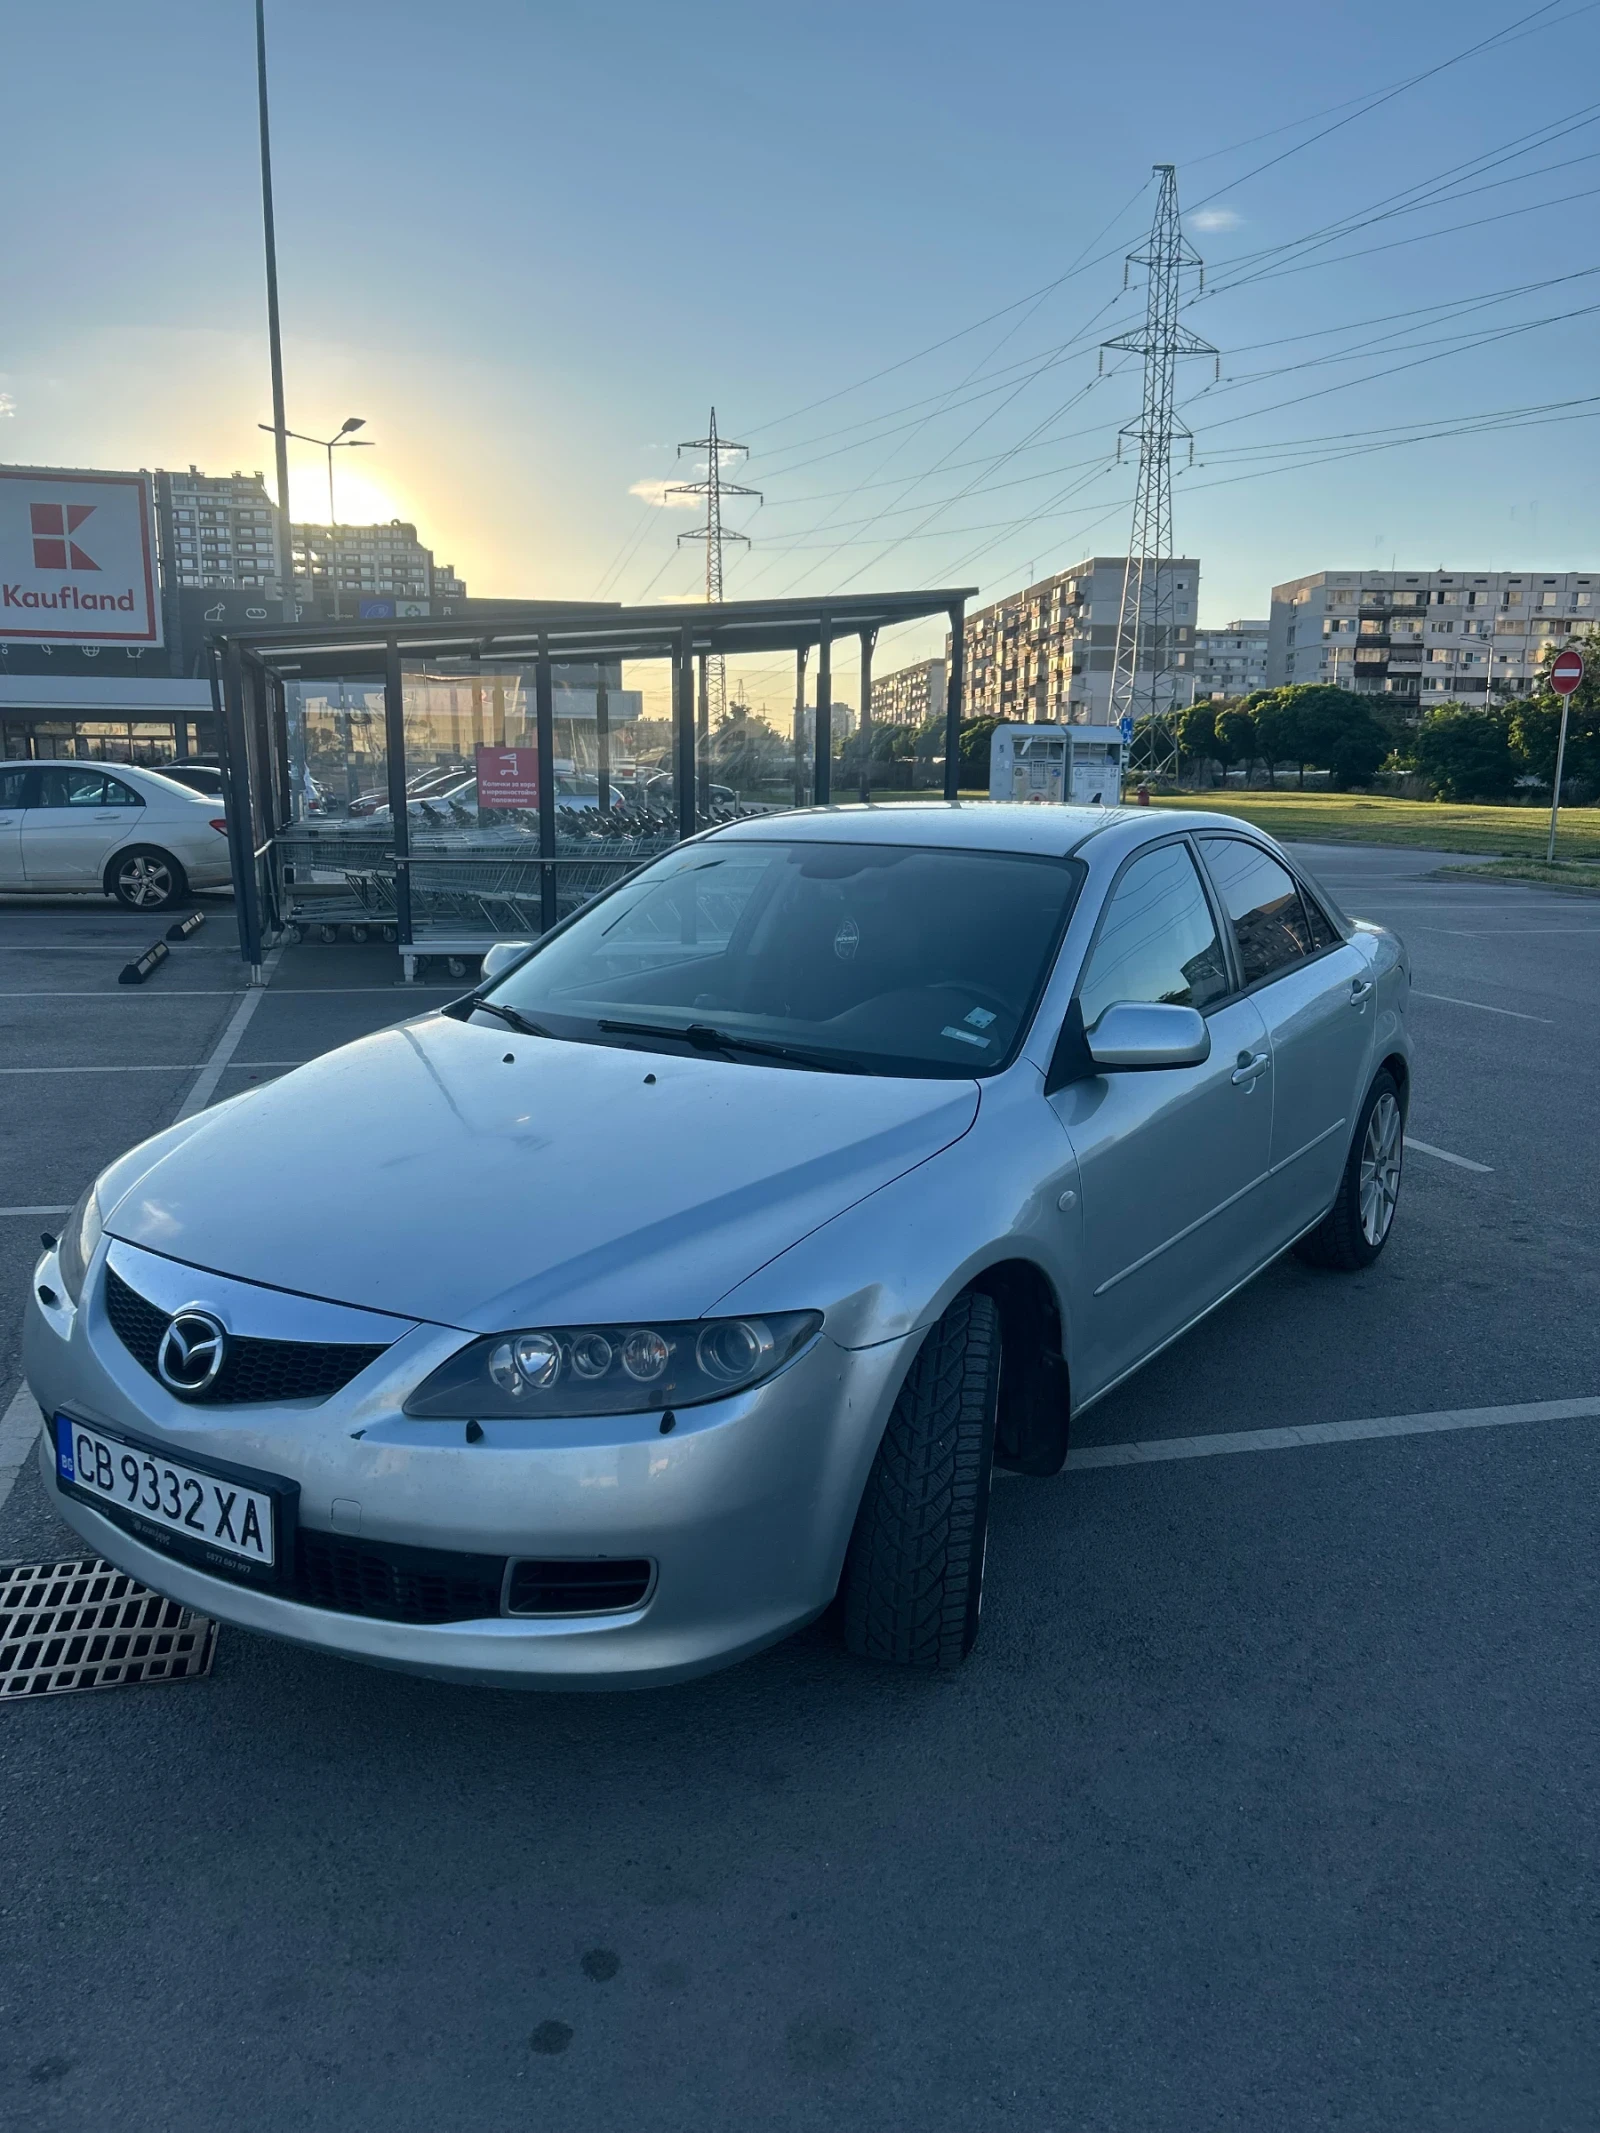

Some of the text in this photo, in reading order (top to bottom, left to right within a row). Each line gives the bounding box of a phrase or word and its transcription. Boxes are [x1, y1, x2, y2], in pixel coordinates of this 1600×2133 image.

[3, 584, 134, 611] Kaufland
[61, 1454, 74, 1472] BG
[77, 1434, 114, 1491] CB
[121, 1454, 205, 1532] 9332
[213, 1486, 264, 1553] XA
